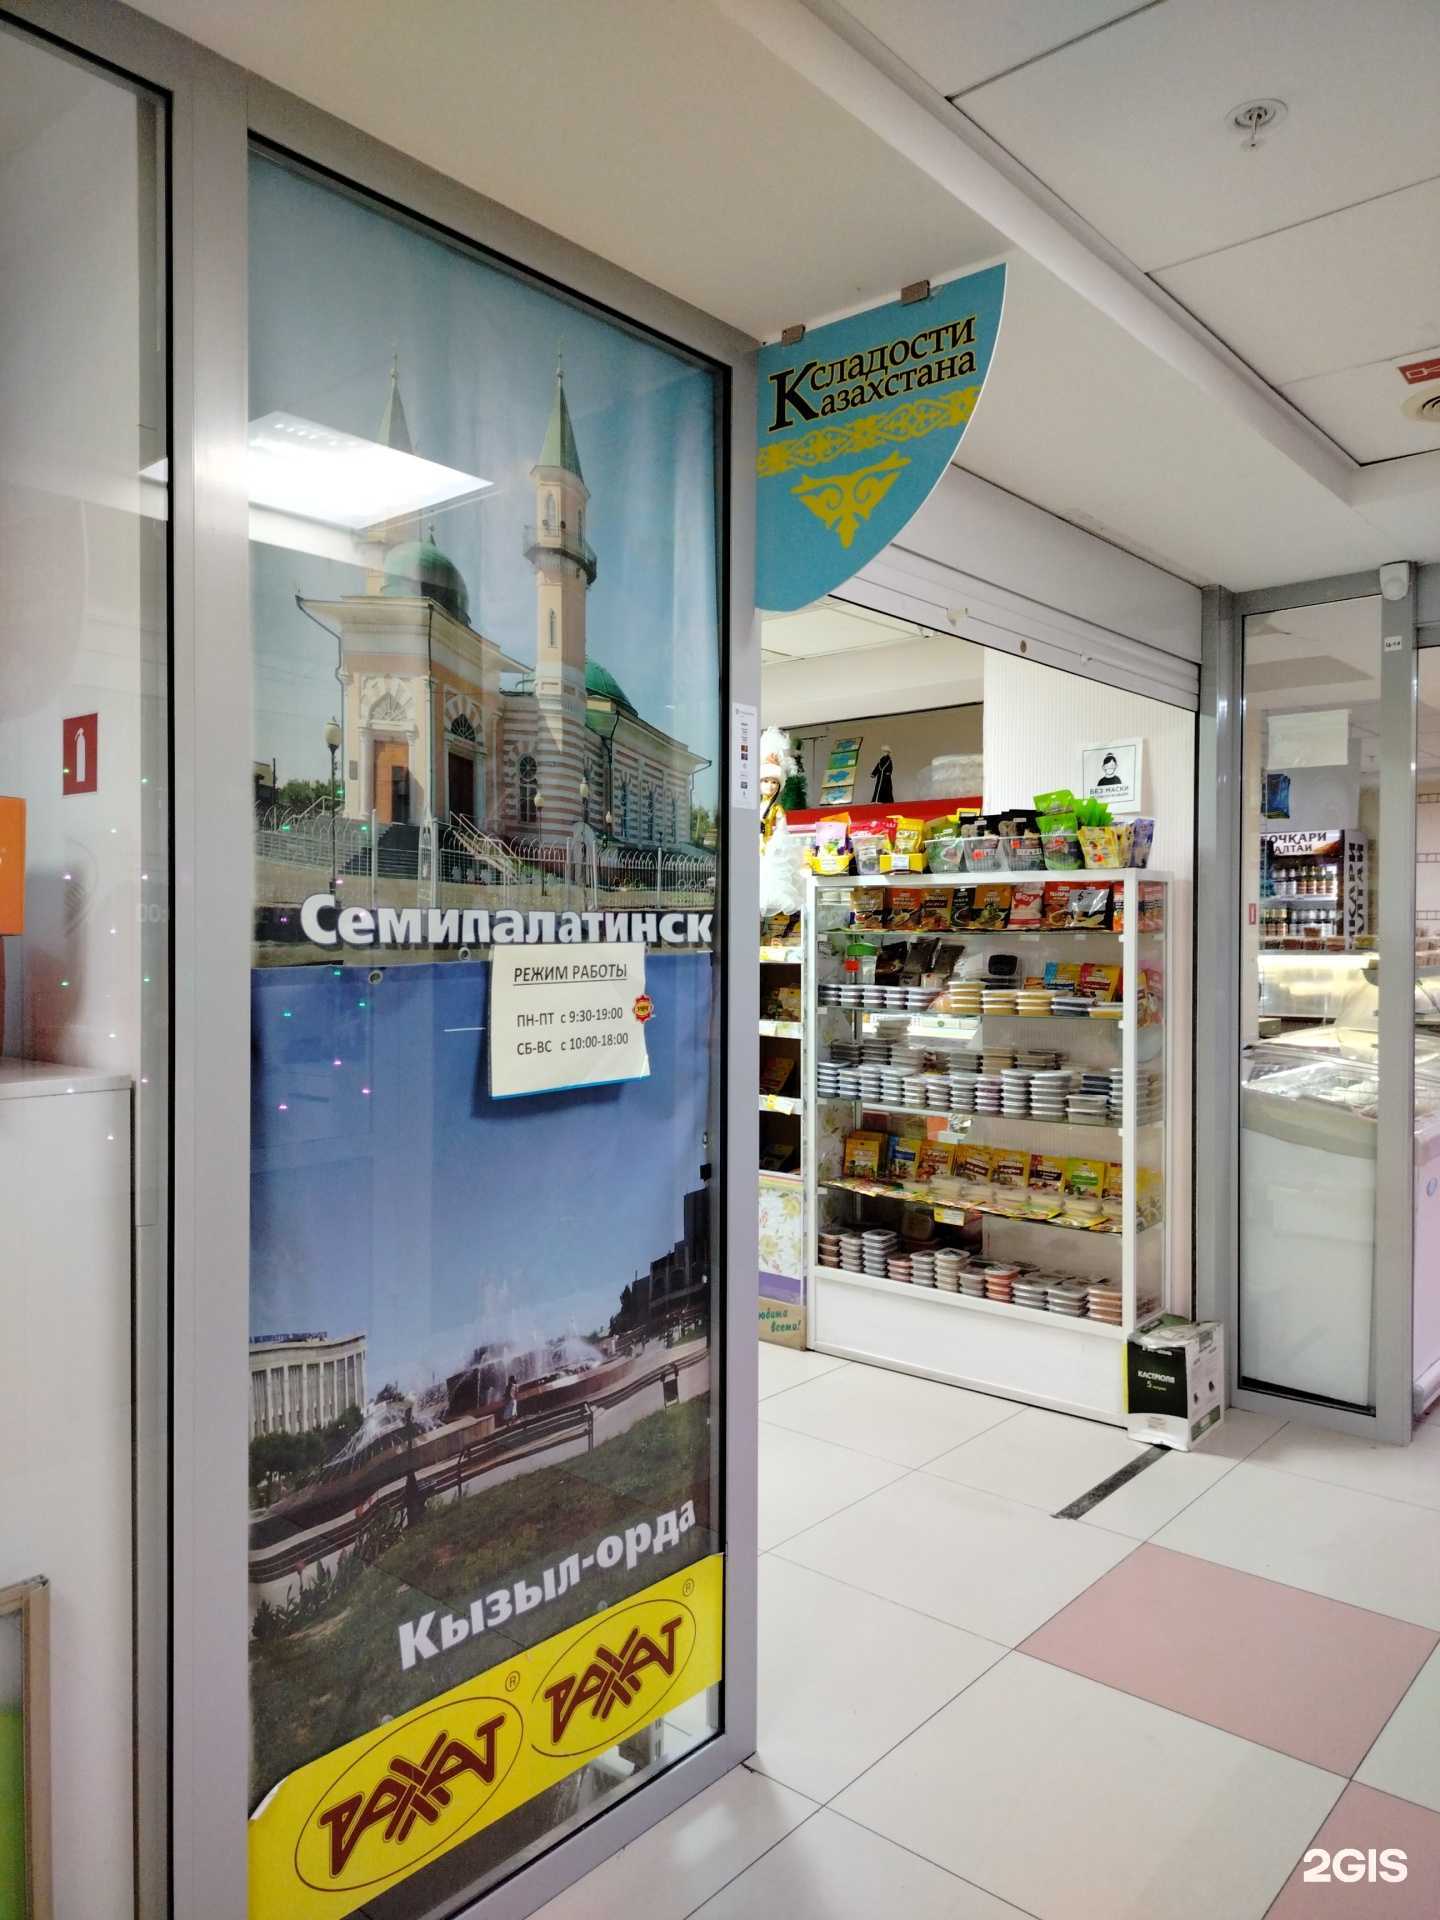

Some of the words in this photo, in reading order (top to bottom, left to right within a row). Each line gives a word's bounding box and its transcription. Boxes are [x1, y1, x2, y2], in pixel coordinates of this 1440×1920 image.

[768, 351, 977, 432] Казахстана
[301, 894, 713, 945] Семипалатинск
[514, 965, 568, 982] РЕЖИМ
[572, 963, 627, 979] РАБОТЫ
[517, 1012, 554, 1027] ПН-ПТ
[560, 1014, 566, 1023] с
[569, 1007, 623, 1023] 9:30-19:00
[517, 1040, 552, 1055] СБ-ВС
[560, 1042, 566, 1051] с
[570, 1032, 629, 1050] 10:00-18:00
[398, 1500, 696, 1671] Кызыл-орда
